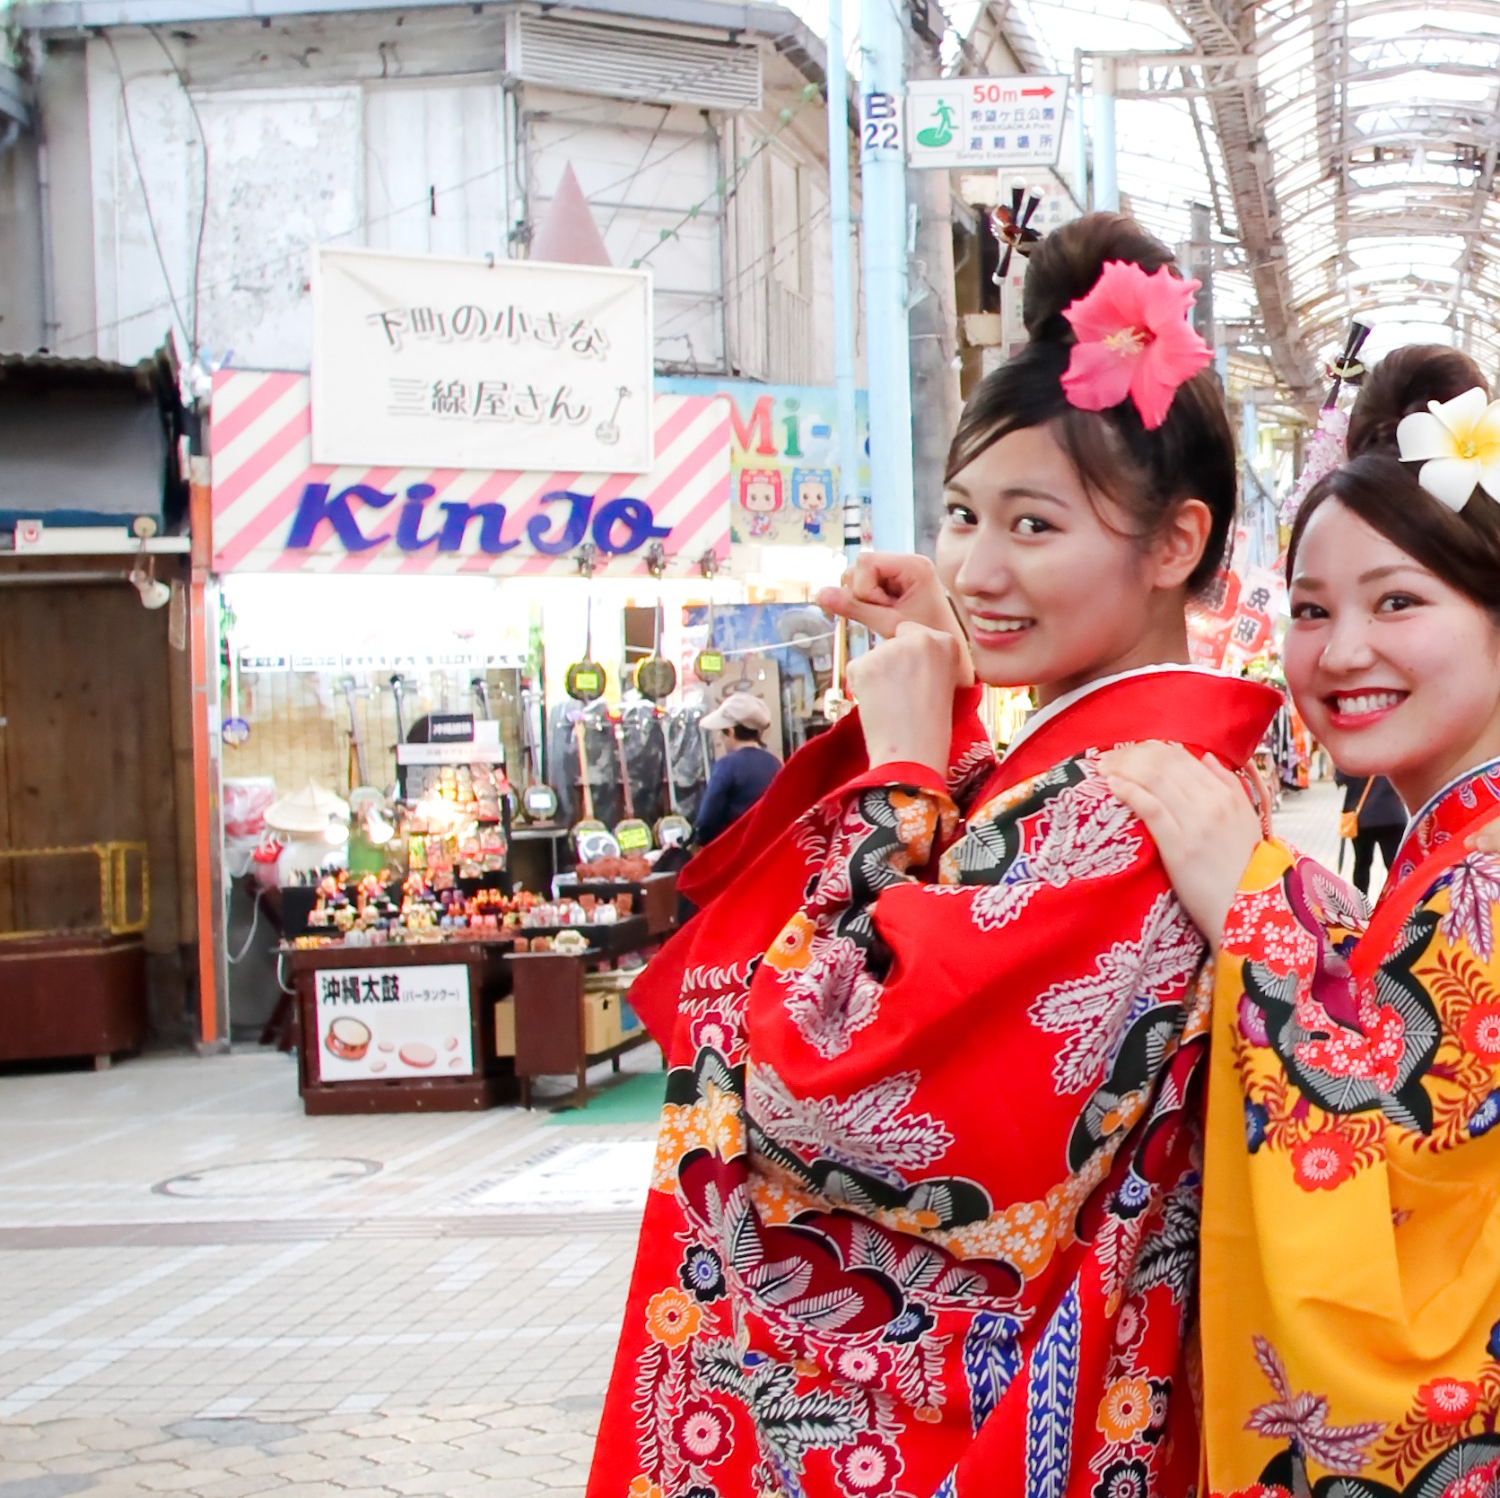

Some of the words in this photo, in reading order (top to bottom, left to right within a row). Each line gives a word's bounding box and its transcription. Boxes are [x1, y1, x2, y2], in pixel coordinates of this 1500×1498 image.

[866, 92, 896, 119] B
[973, 85, 1018, 103] 50m
[864, 123, 899, 150] 22
[366, 304, 611, 360] 下町の小さな
[387, 378, 590, 423] 三線屋さん
[286, 482, 672, 557] KinJo
